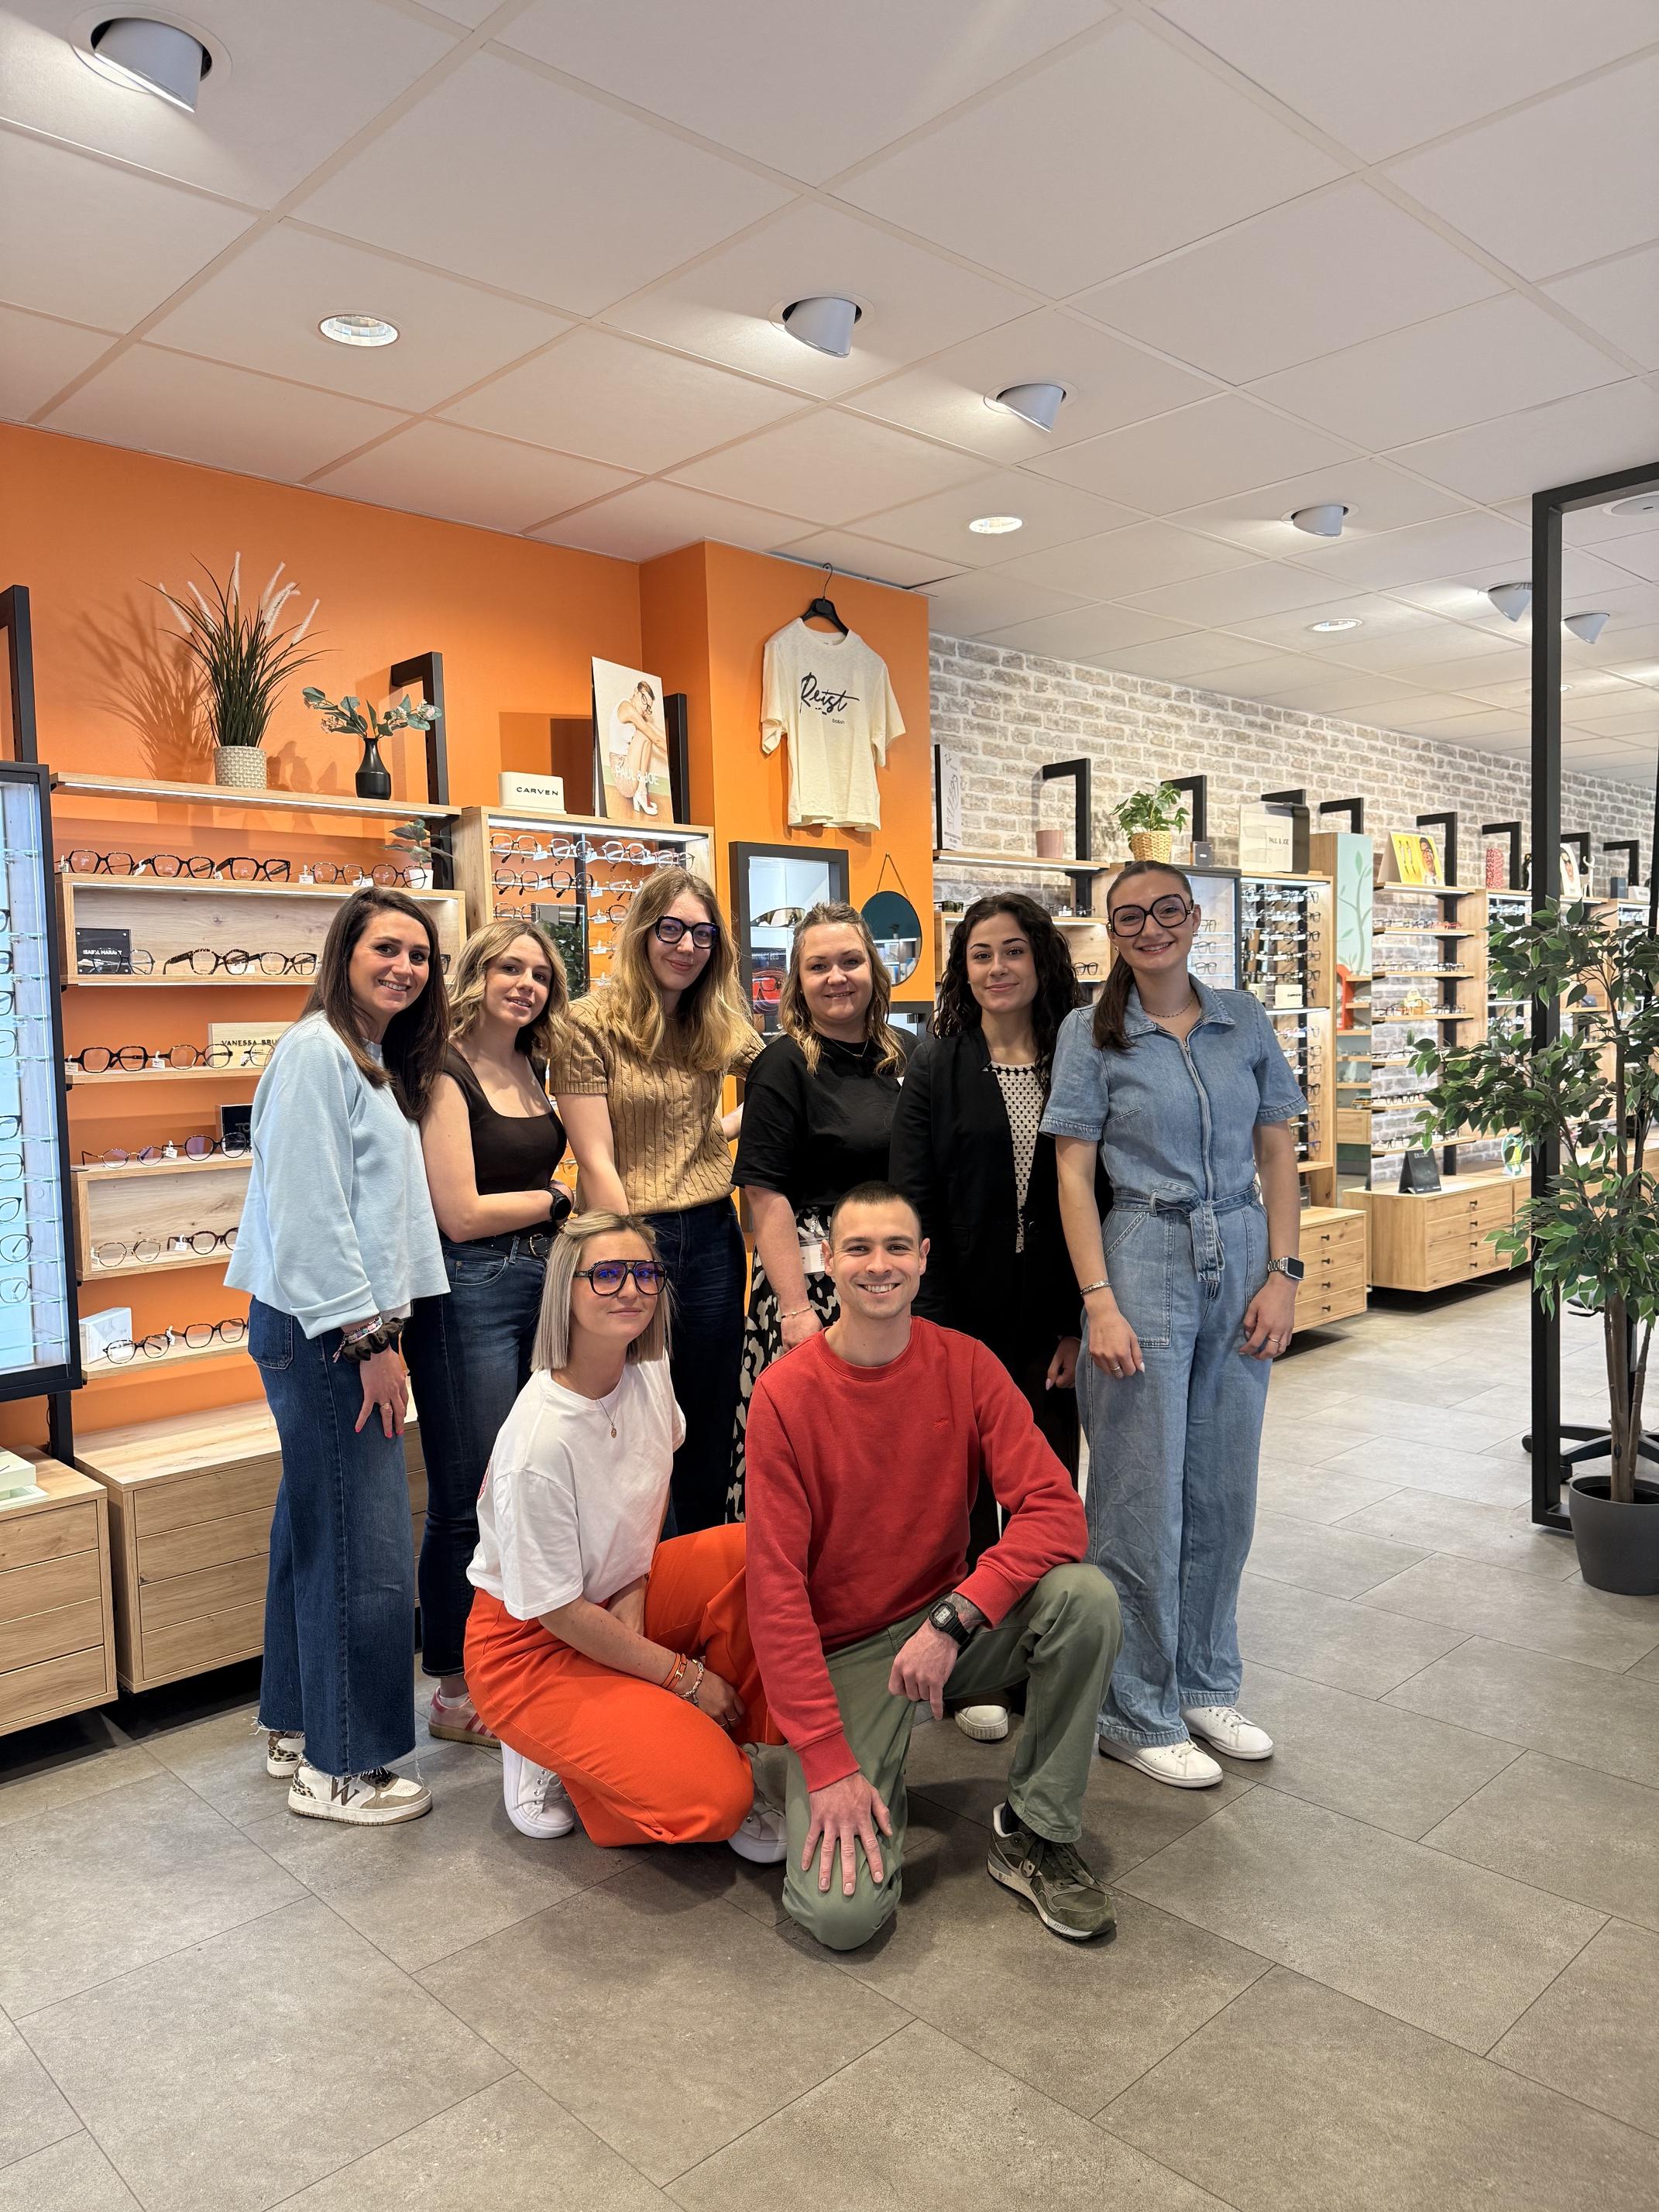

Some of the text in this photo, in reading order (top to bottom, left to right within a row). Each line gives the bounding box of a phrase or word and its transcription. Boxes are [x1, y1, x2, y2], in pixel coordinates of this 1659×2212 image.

[615, 765, 660, 785] PAUL & JOE
[516, 787, 558, 796] CARVEN
